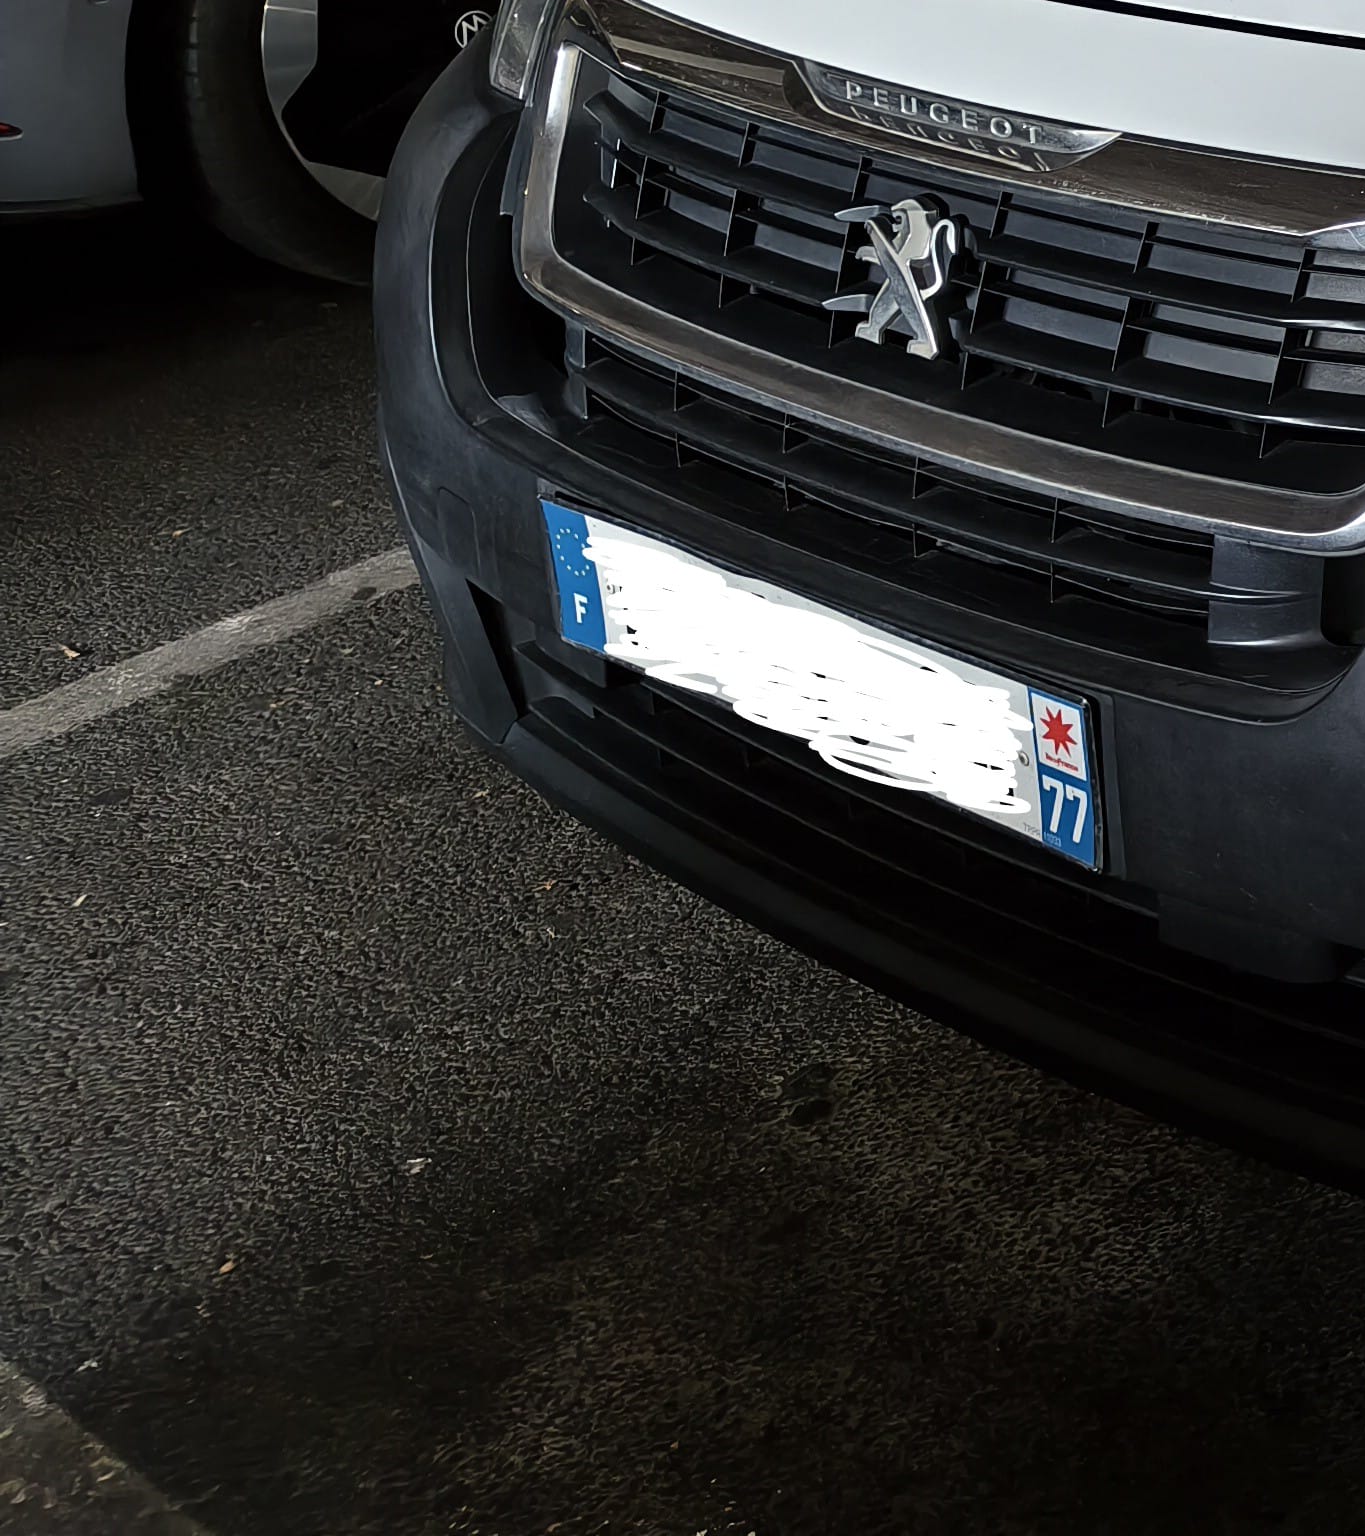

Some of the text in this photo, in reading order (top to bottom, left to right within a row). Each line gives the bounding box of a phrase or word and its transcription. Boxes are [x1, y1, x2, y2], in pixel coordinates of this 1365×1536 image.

[844, 79, 1044, 146] PEUGEOT
[573, 592, 588, 624] F
[1042, 774, 1087, 843] 77
